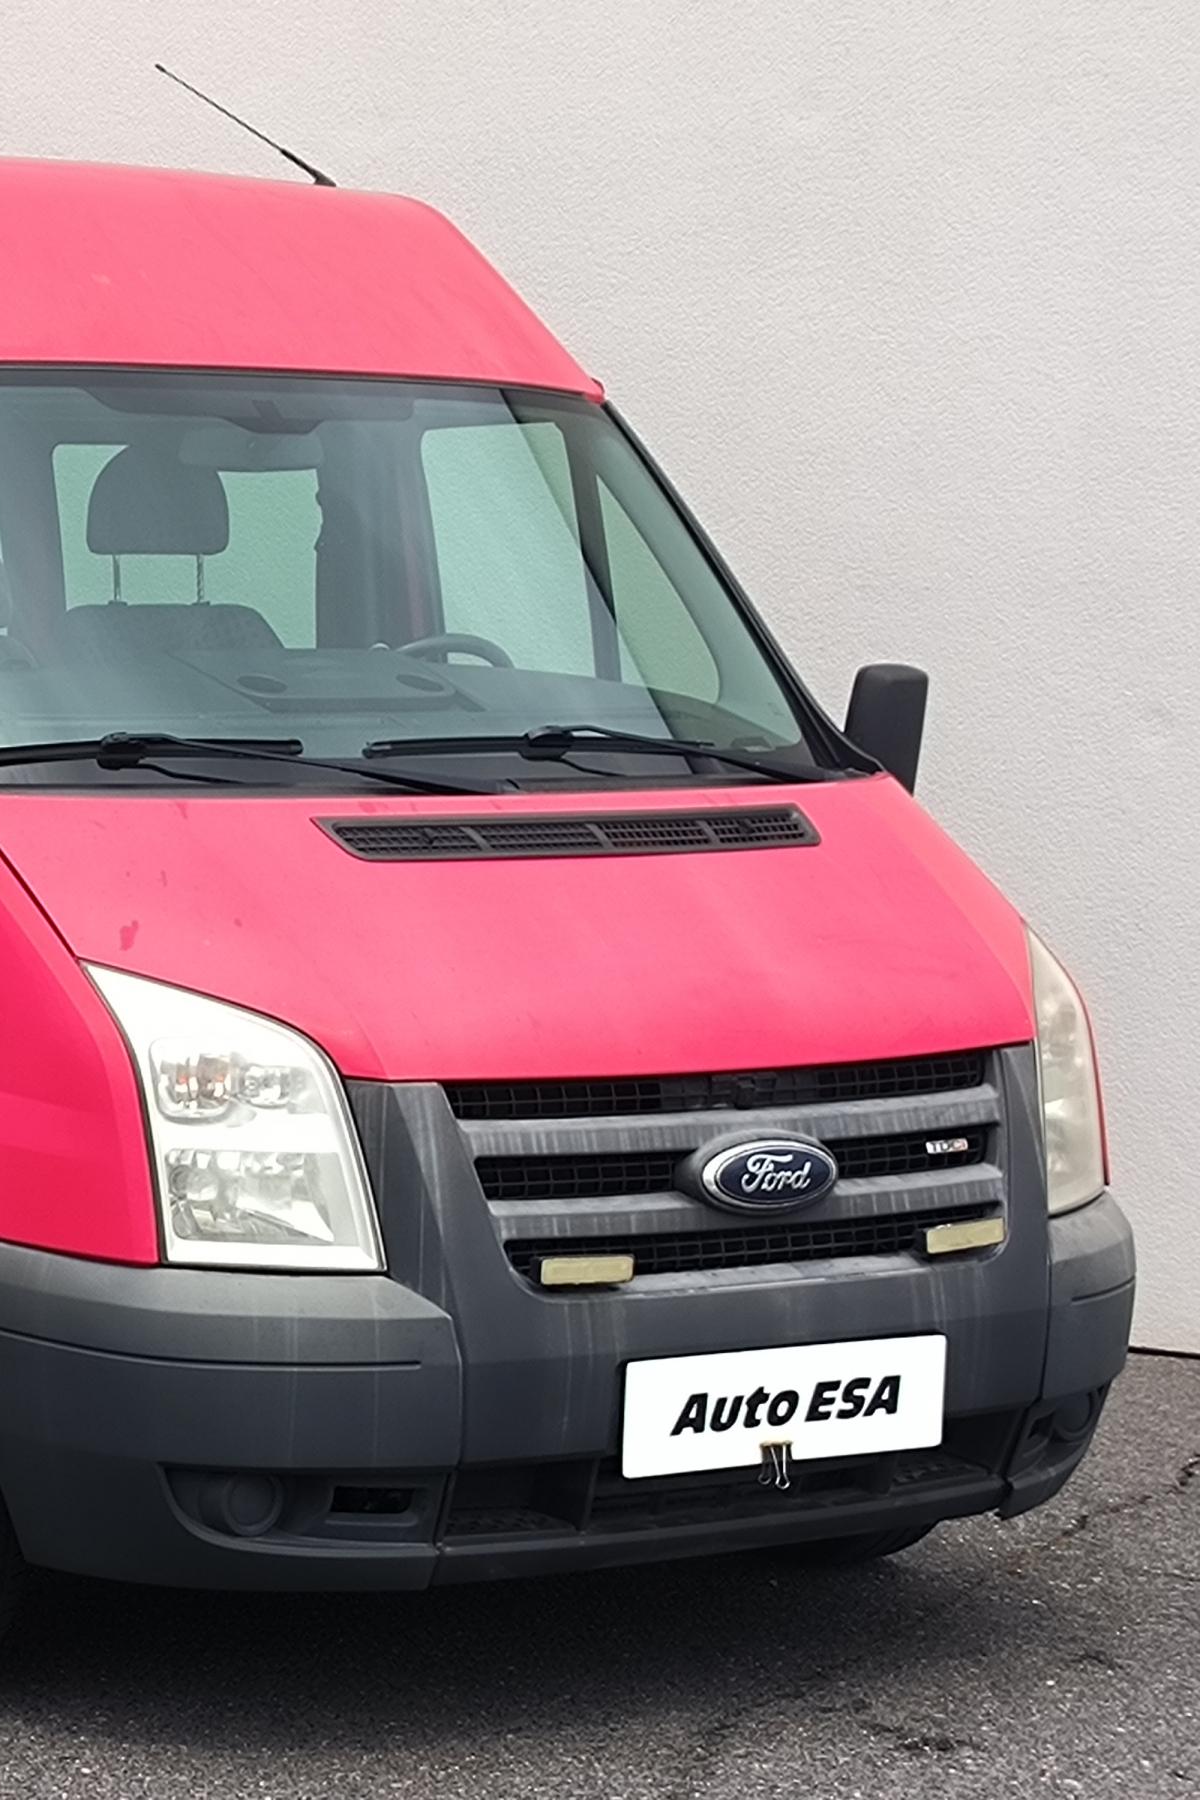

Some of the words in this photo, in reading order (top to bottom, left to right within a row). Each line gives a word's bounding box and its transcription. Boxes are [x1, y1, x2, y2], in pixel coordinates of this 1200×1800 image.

[741, 1153, 812, 1193] Ford
[669, 1386, 800, 1436] Auto
[804, 1375, 901, 1422] ESA
